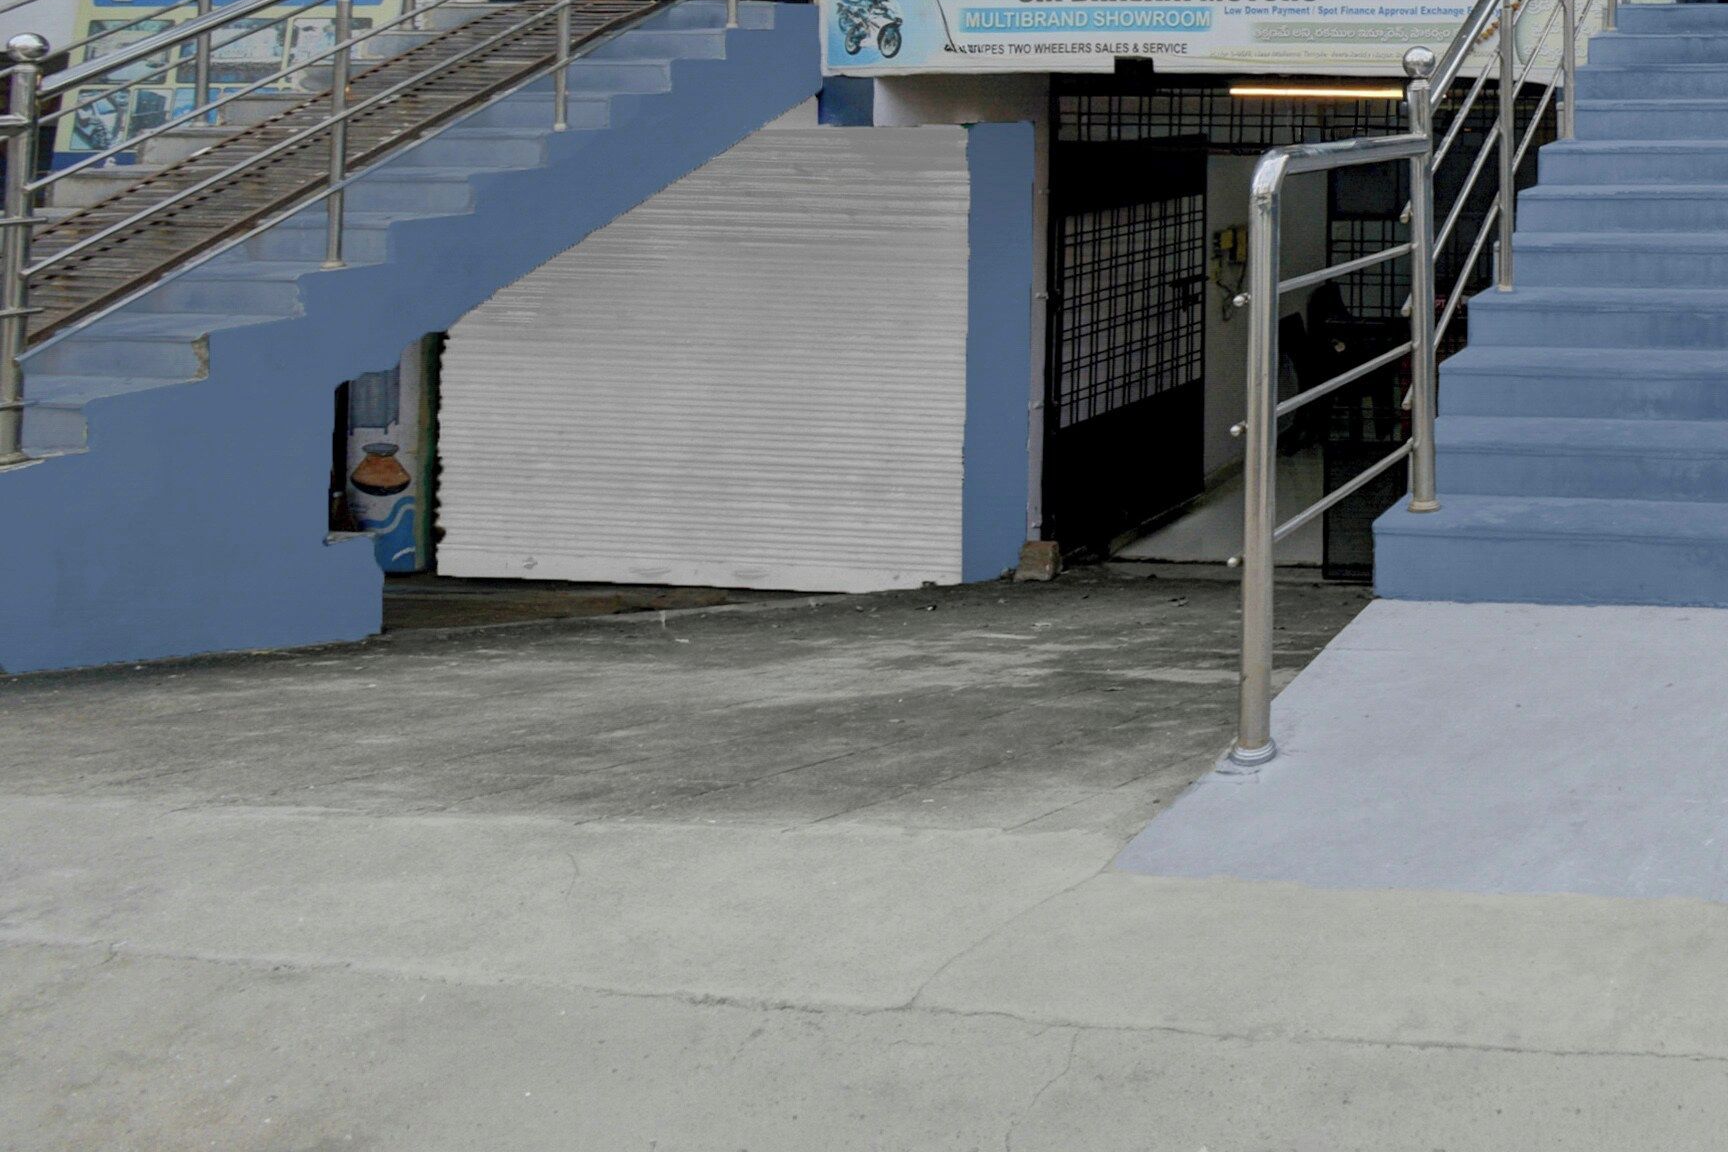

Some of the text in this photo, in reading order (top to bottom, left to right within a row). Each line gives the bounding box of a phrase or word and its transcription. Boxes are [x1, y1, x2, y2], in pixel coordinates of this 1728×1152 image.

[1224, 6, 1242, 15] Low
[1245, 6, 1269, 15] Down
[1271, 6, 1310, 17] Payment
[1318, 6, 1338, 17] Spot
[1341, 6, 1376, 16] Finance
[1378, 5, 1418, 17] Approval
[1420, 6, 1464, 17] Exchange
[966, 10, 1211, 29] MULTIBRAND SHOWROOM
[1008, 43, 1032, 54] TWO
[1034, 43, 1092, 54] WHEELERS
[1095, 43, 1129, 54] SALES
[1132, 43, 1141, 54] &
[1143, 42, 1188, 54] SERVICE
